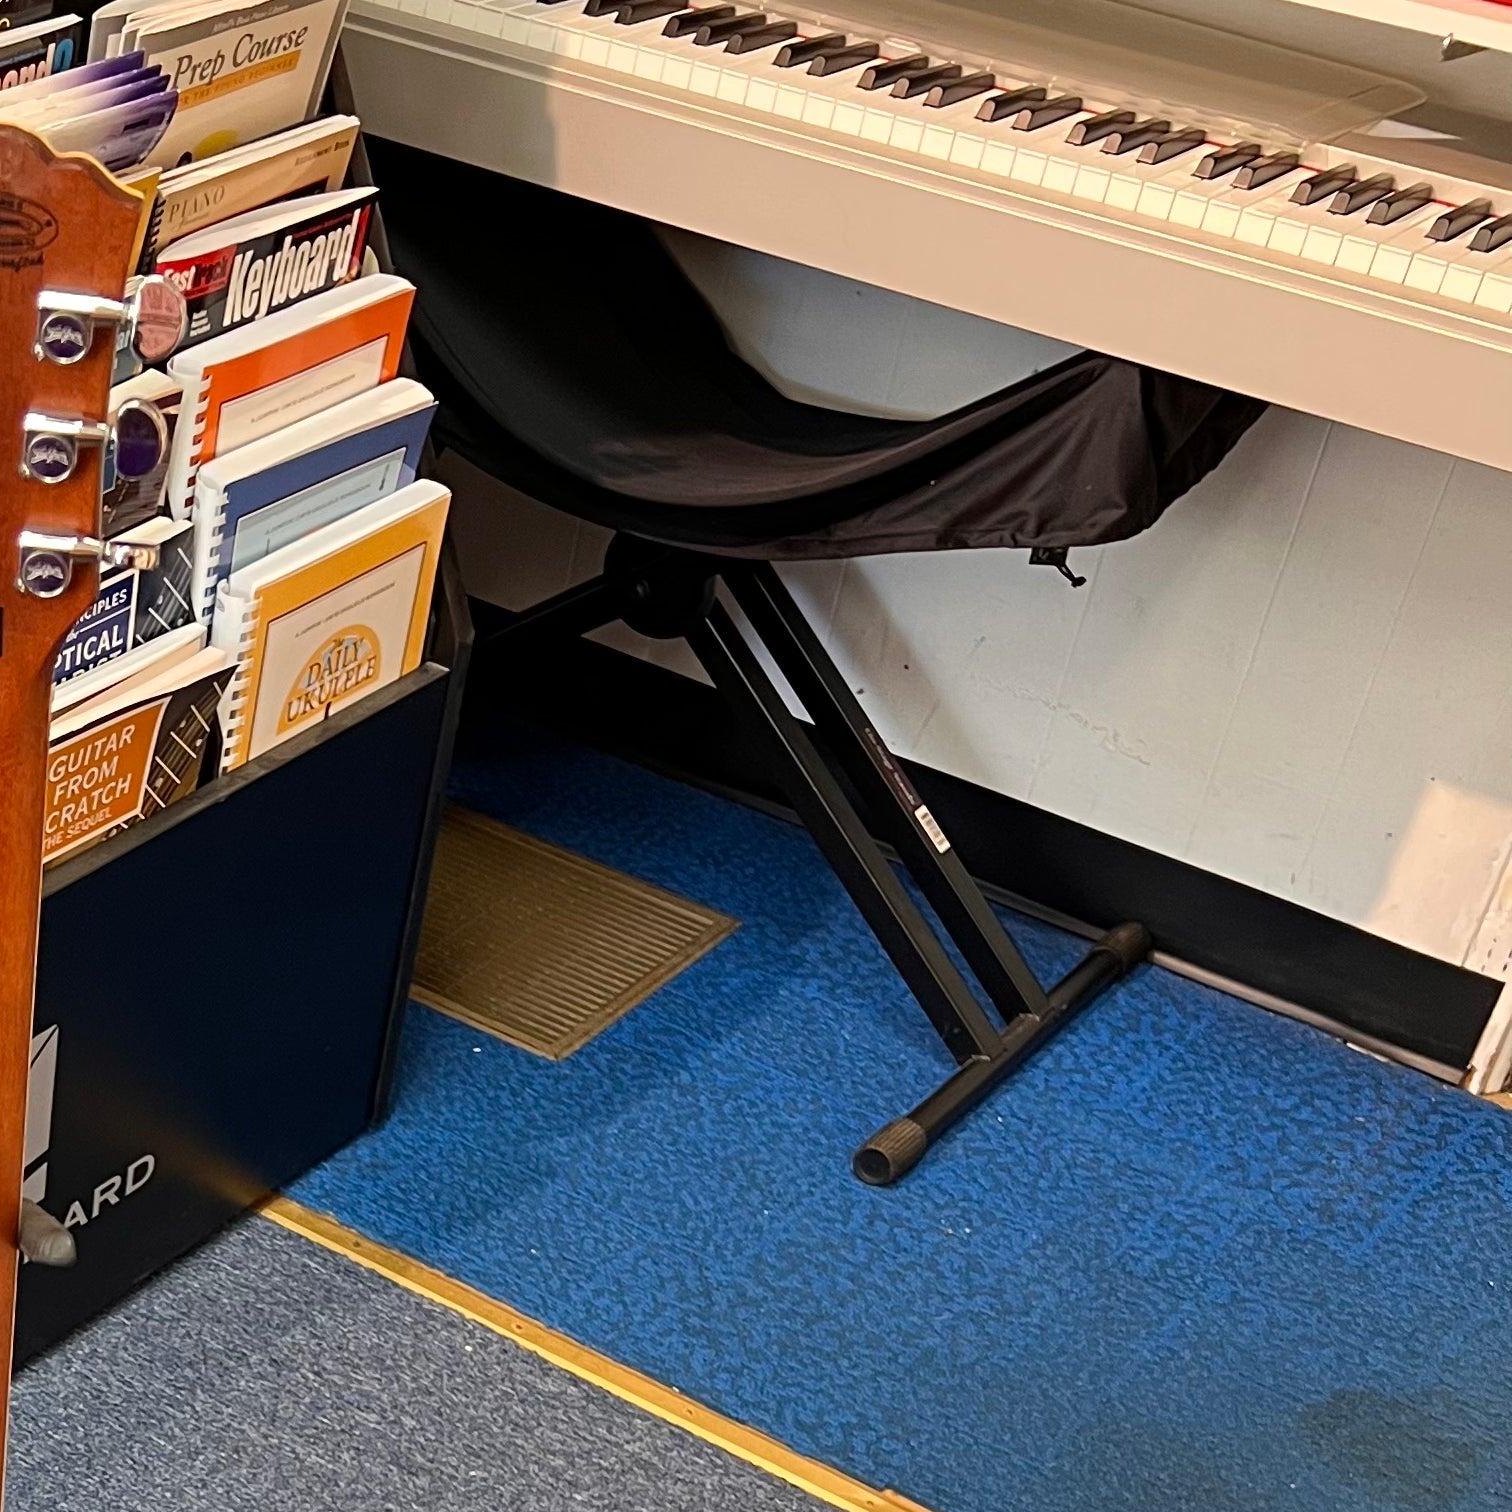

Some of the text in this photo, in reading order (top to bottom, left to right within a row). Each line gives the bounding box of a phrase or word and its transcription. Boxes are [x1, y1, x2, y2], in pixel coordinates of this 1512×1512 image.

[175, 25, 308, 88] Prep Course
[168, 185, 225, 224] PIANO
[223, 208, 361, 327] Keyboard
[287, 656, 377, 722] UKULELE
[307, 638, 364, 688] DAILY
[49, 724, 136, 782] GUITAR
[54, 755, 119, 806] FROM
[45, 773, 132, 834] CRATCH
[66, 807, 113, 839] SEQUEL
